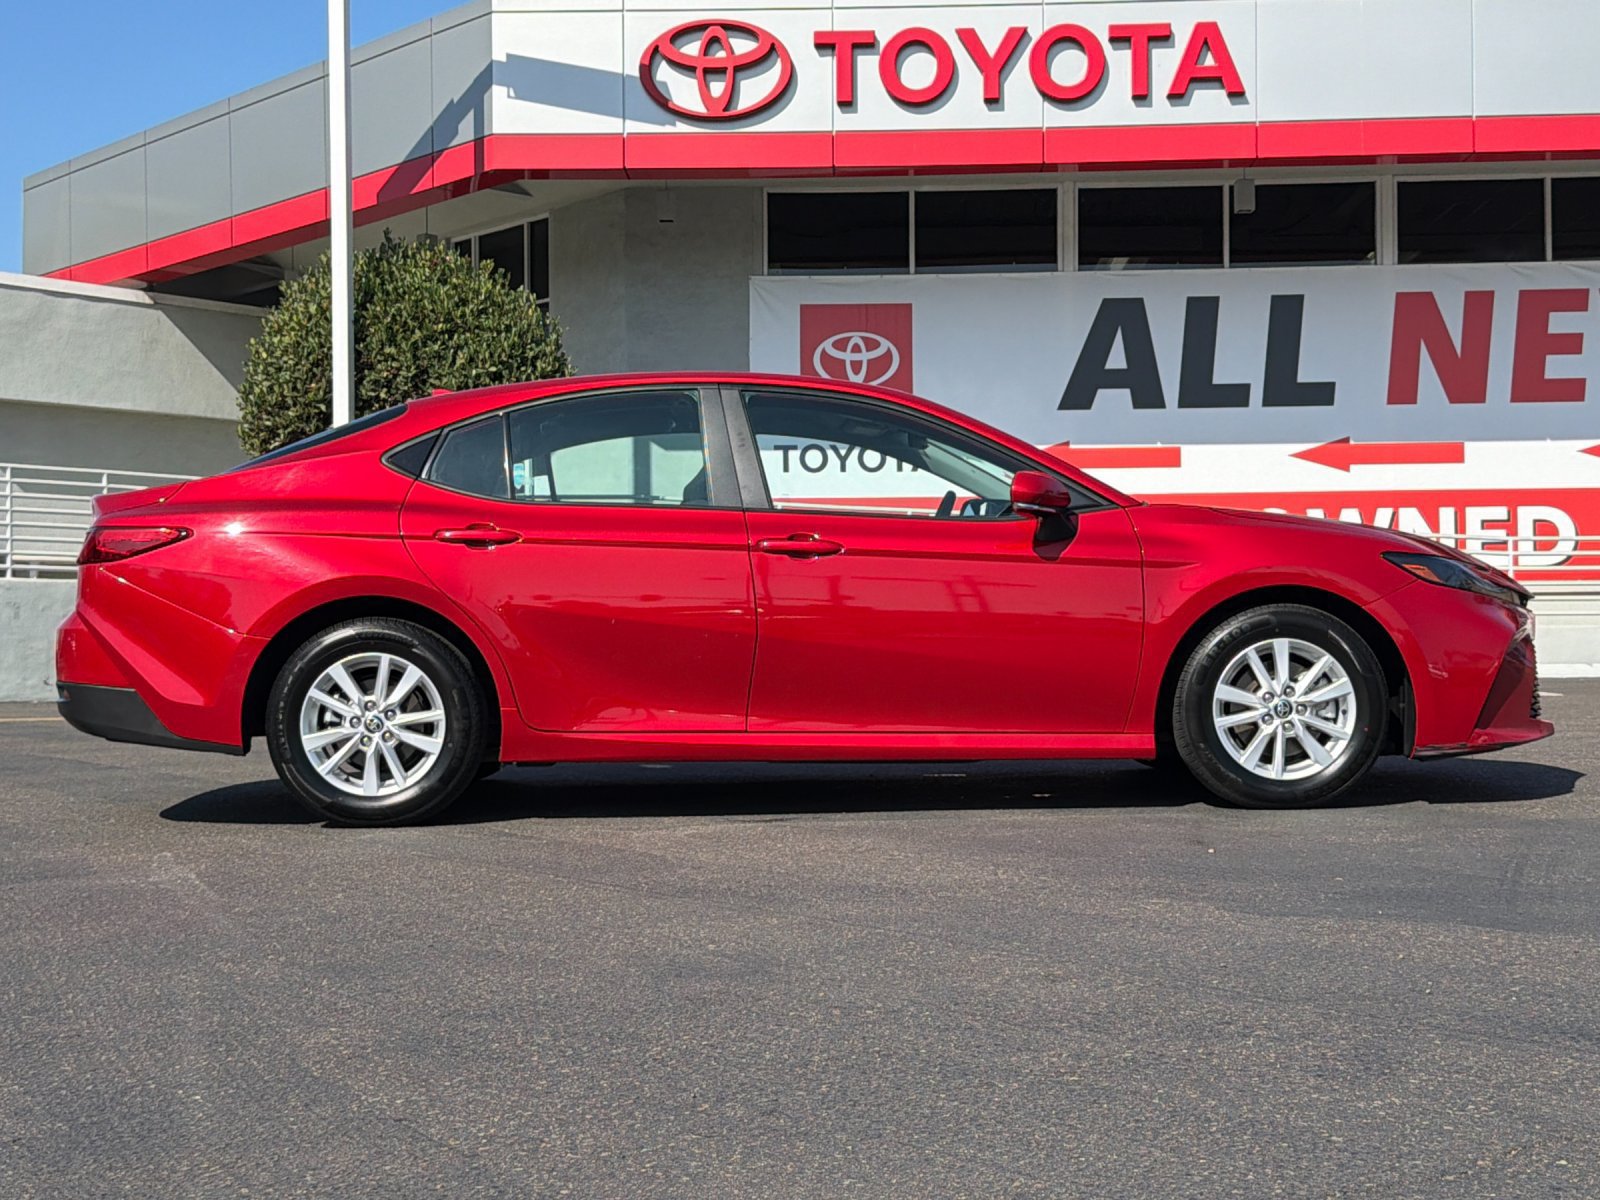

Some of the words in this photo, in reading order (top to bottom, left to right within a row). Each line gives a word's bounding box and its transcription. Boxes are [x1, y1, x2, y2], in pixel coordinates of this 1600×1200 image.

[814, 22, 1246, 107] TOYOTA
[1058, 294, 1337, 410] ALL
[1388, 287, 1600, 404] NE
[773, 443, 920, 473] TOYO
[1264, 505, 1577, 567] NED
